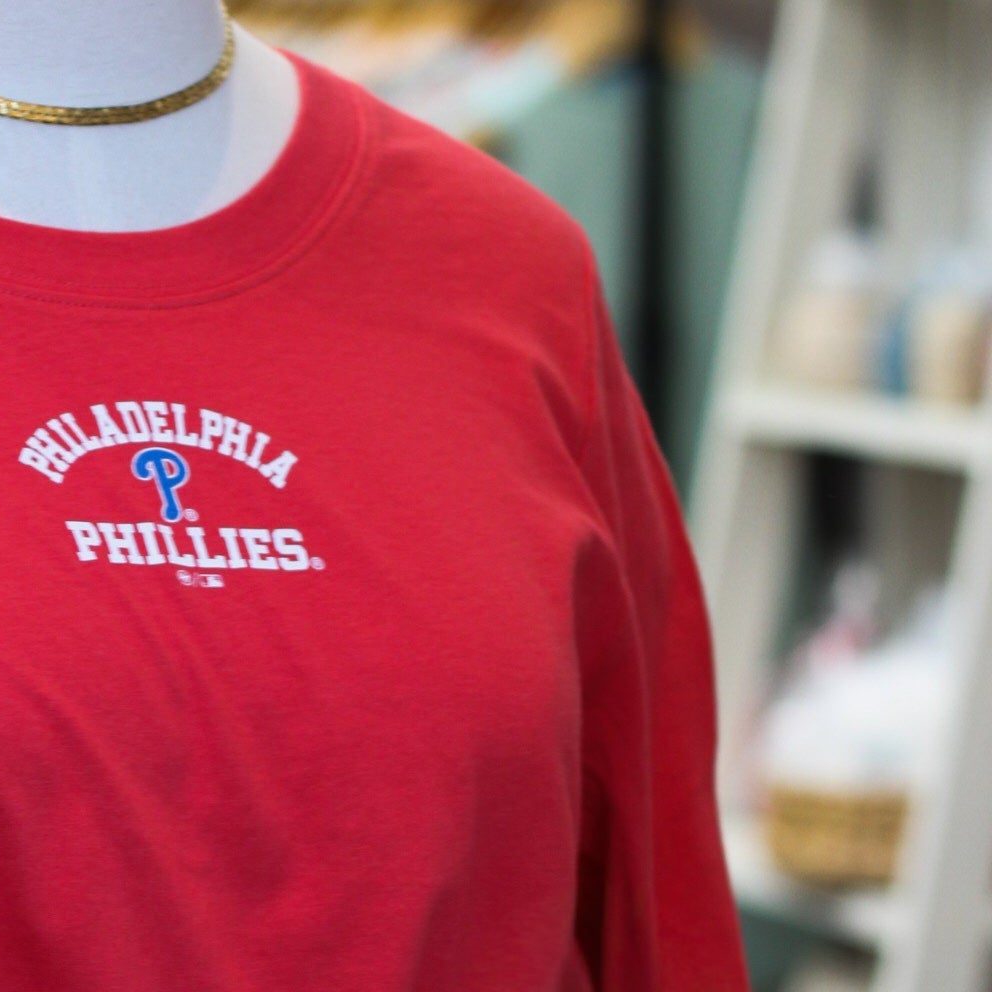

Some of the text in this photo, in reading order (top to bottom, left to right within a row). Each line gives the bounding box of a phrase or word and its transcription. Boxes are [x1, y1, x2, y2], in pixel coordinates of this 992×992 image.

[18, 401, 298, 489] PHILADELPHIA
[131, 447, 190, 523] P
[65, 520, 310, 571] PHILLIES
